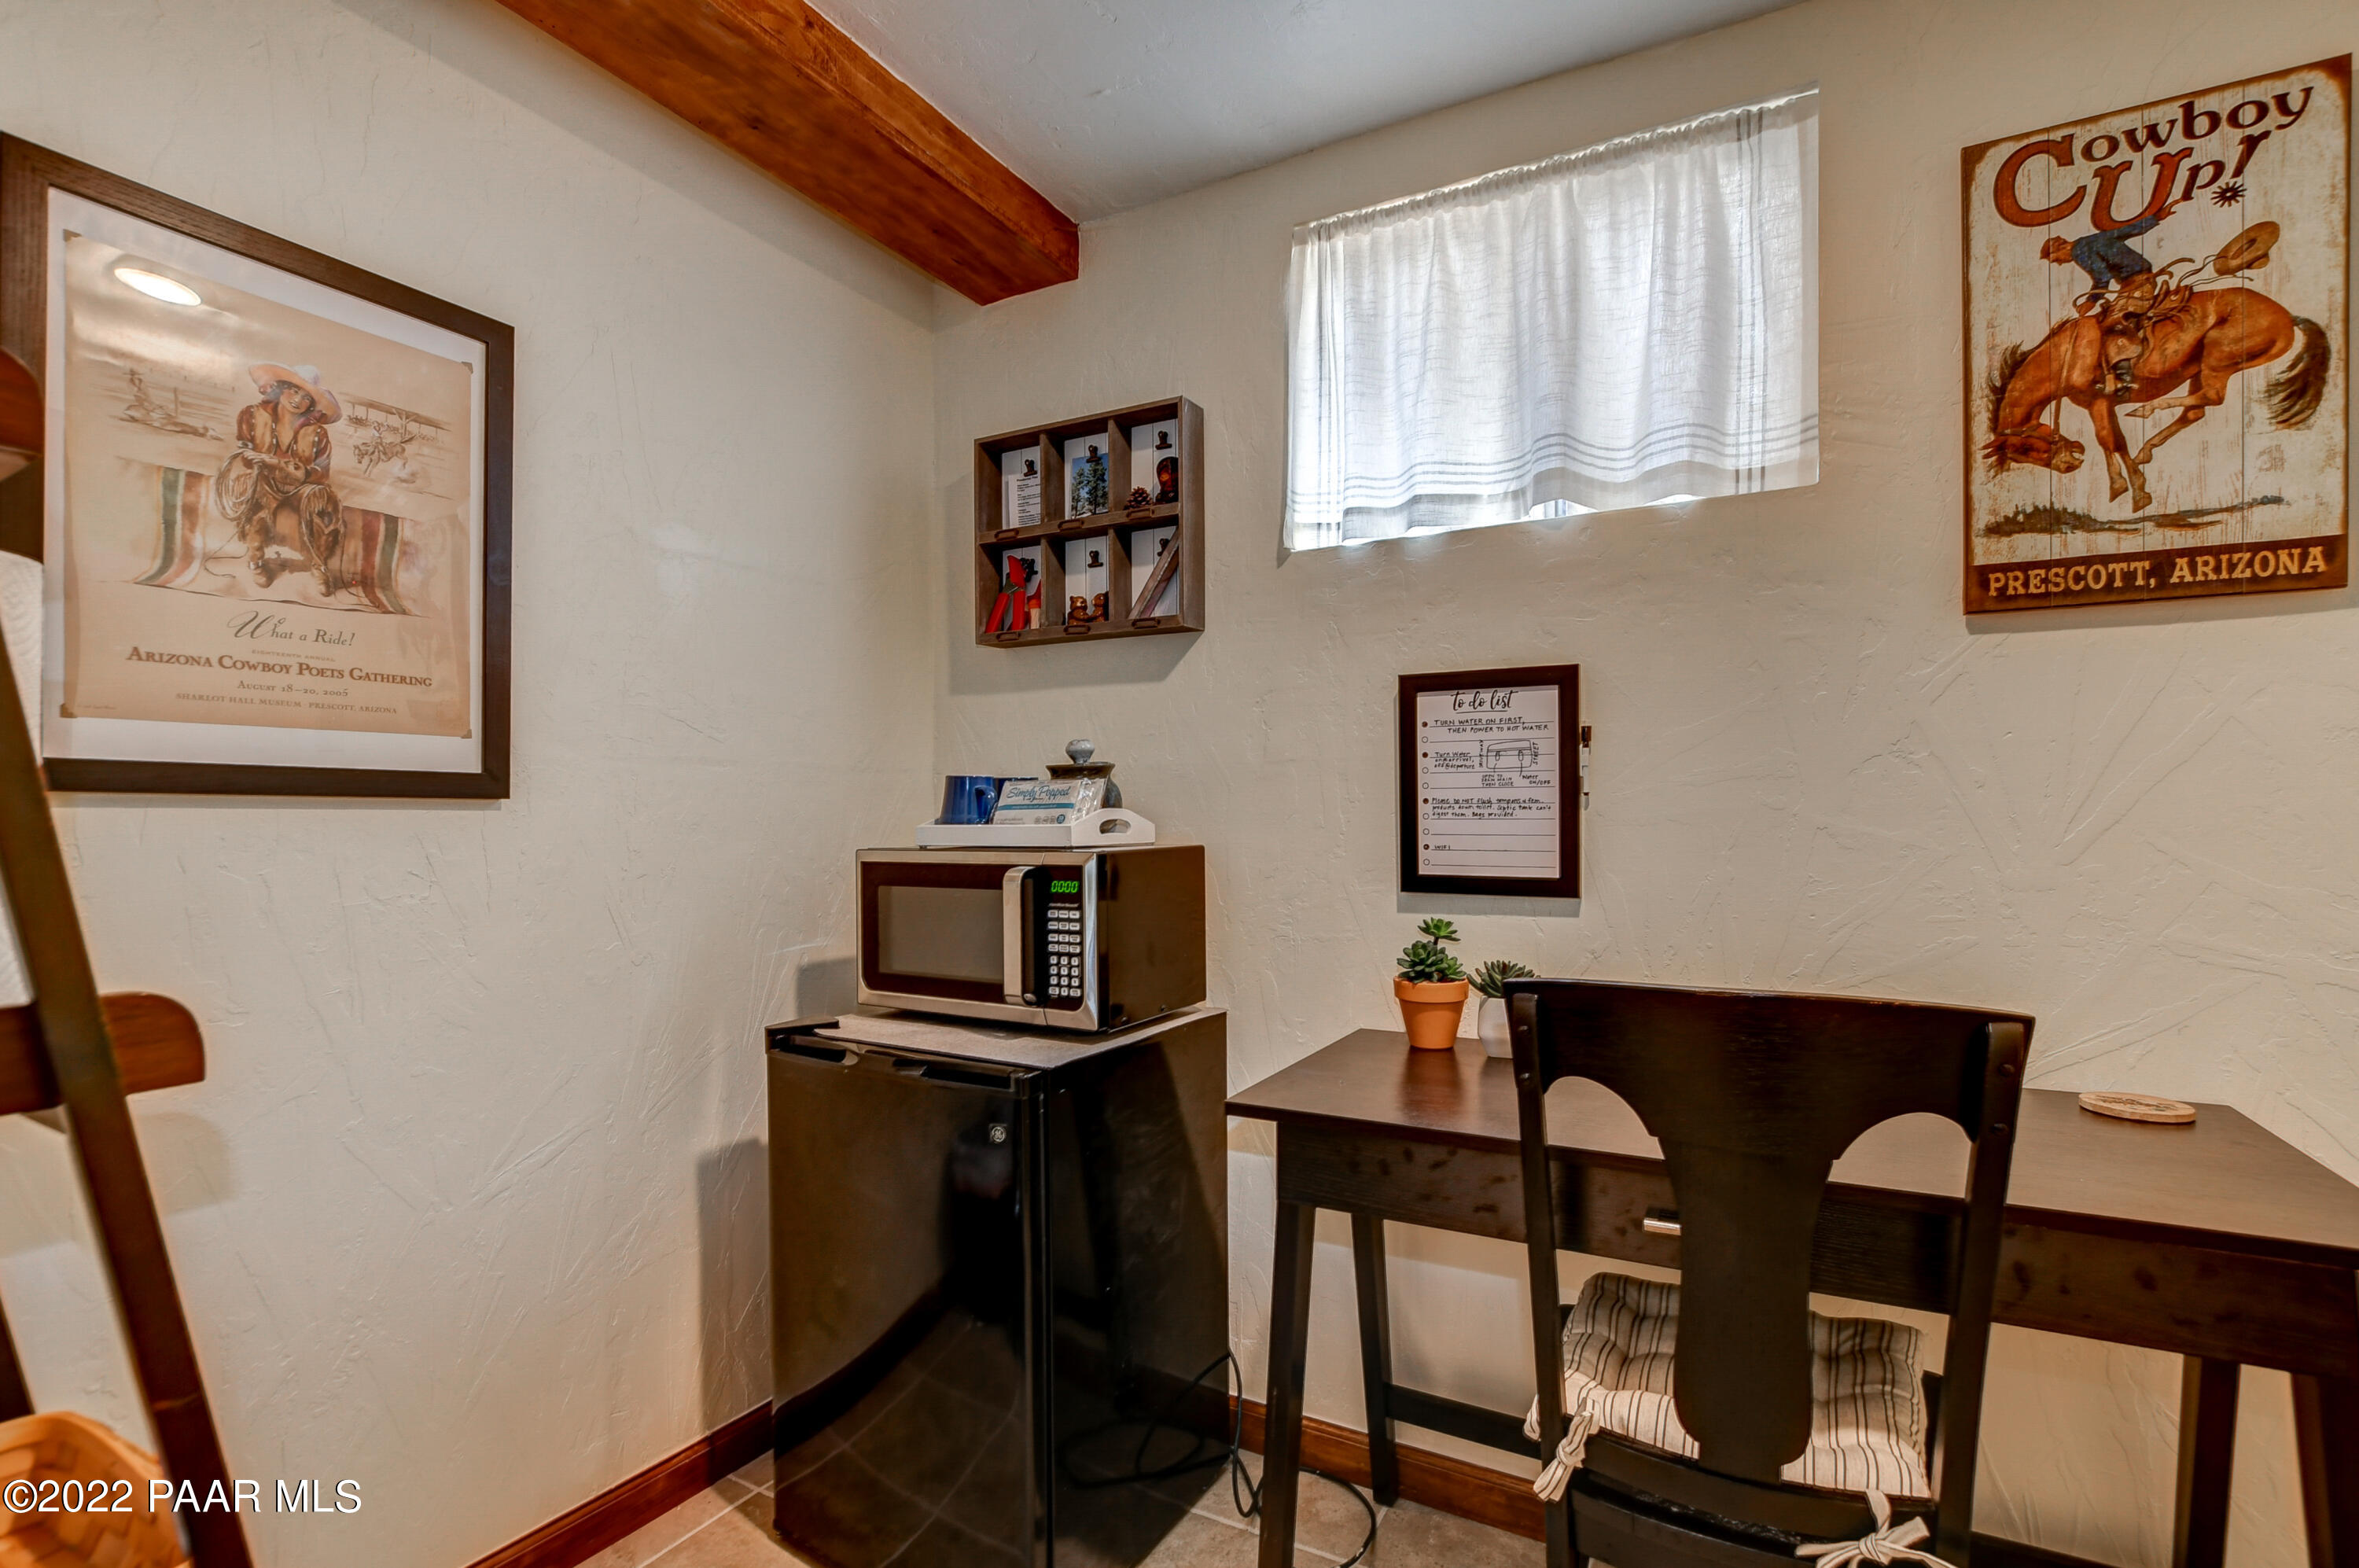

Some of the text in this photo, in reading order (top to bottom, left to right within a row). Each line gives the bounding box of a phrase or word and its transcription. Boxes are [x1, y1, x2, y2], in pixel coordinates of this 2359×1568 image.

[1993, 86, 2314, 228] Cowboy
[2090, 130, 2273, 231] Up!
[1988, 545, 2328, 596] PRESCOTT, ARIZONA
[226, 610, 356, 646] What a Ride!
[125, 646, 433, 687] ARIZONA COWBOY POETS GATHERING
[175, 692, 227, 704] SHARLOT
[229, 696, 256, 705] HALL
[259, 698, 302, 708] MUSEUM
[1450, 689, 1519, 712] to do list
[1007, 785, 1071, 803] Simply Popped
